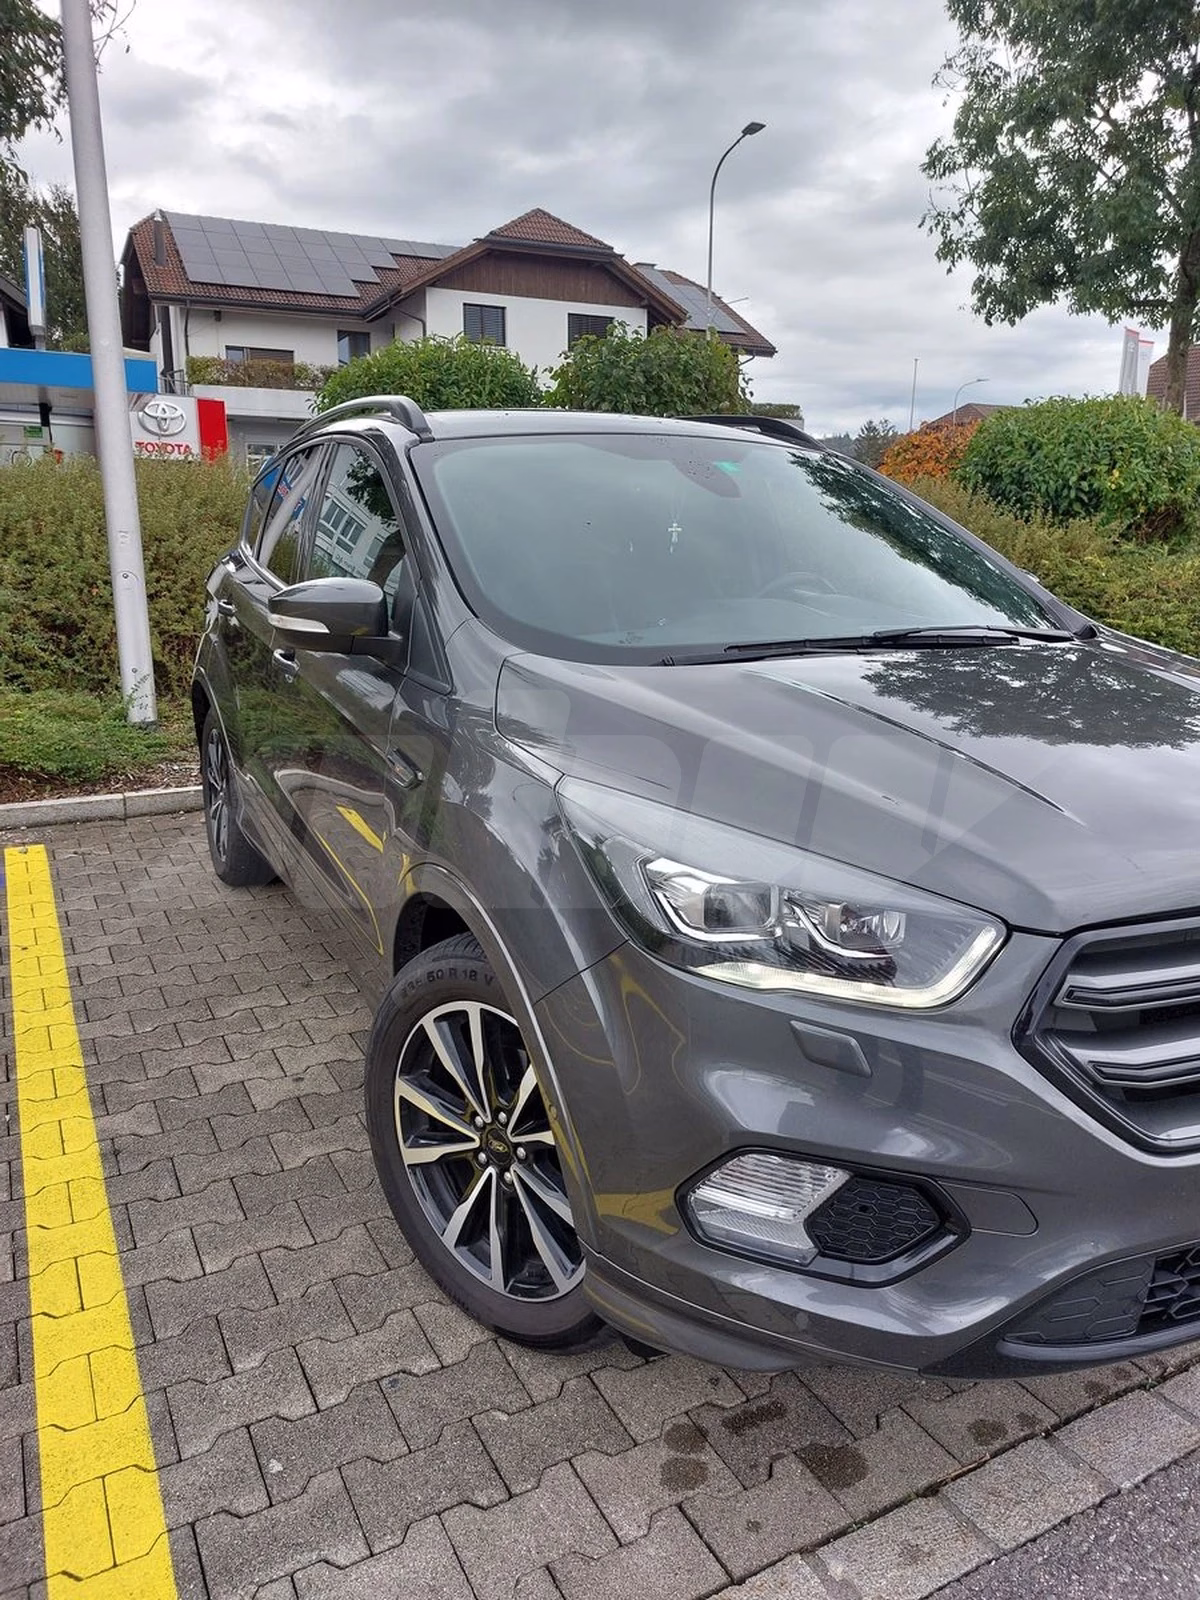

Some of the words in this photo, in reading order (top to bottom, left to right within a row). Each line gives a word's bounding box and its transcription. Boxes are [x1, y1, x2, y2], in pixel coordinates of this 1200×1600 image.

[135, 441, 192, 455] TOYOTA
[426, 968, 445, 983] 50
[448, 967, 459, 980] R
[461, 969, 478, 981] 18
